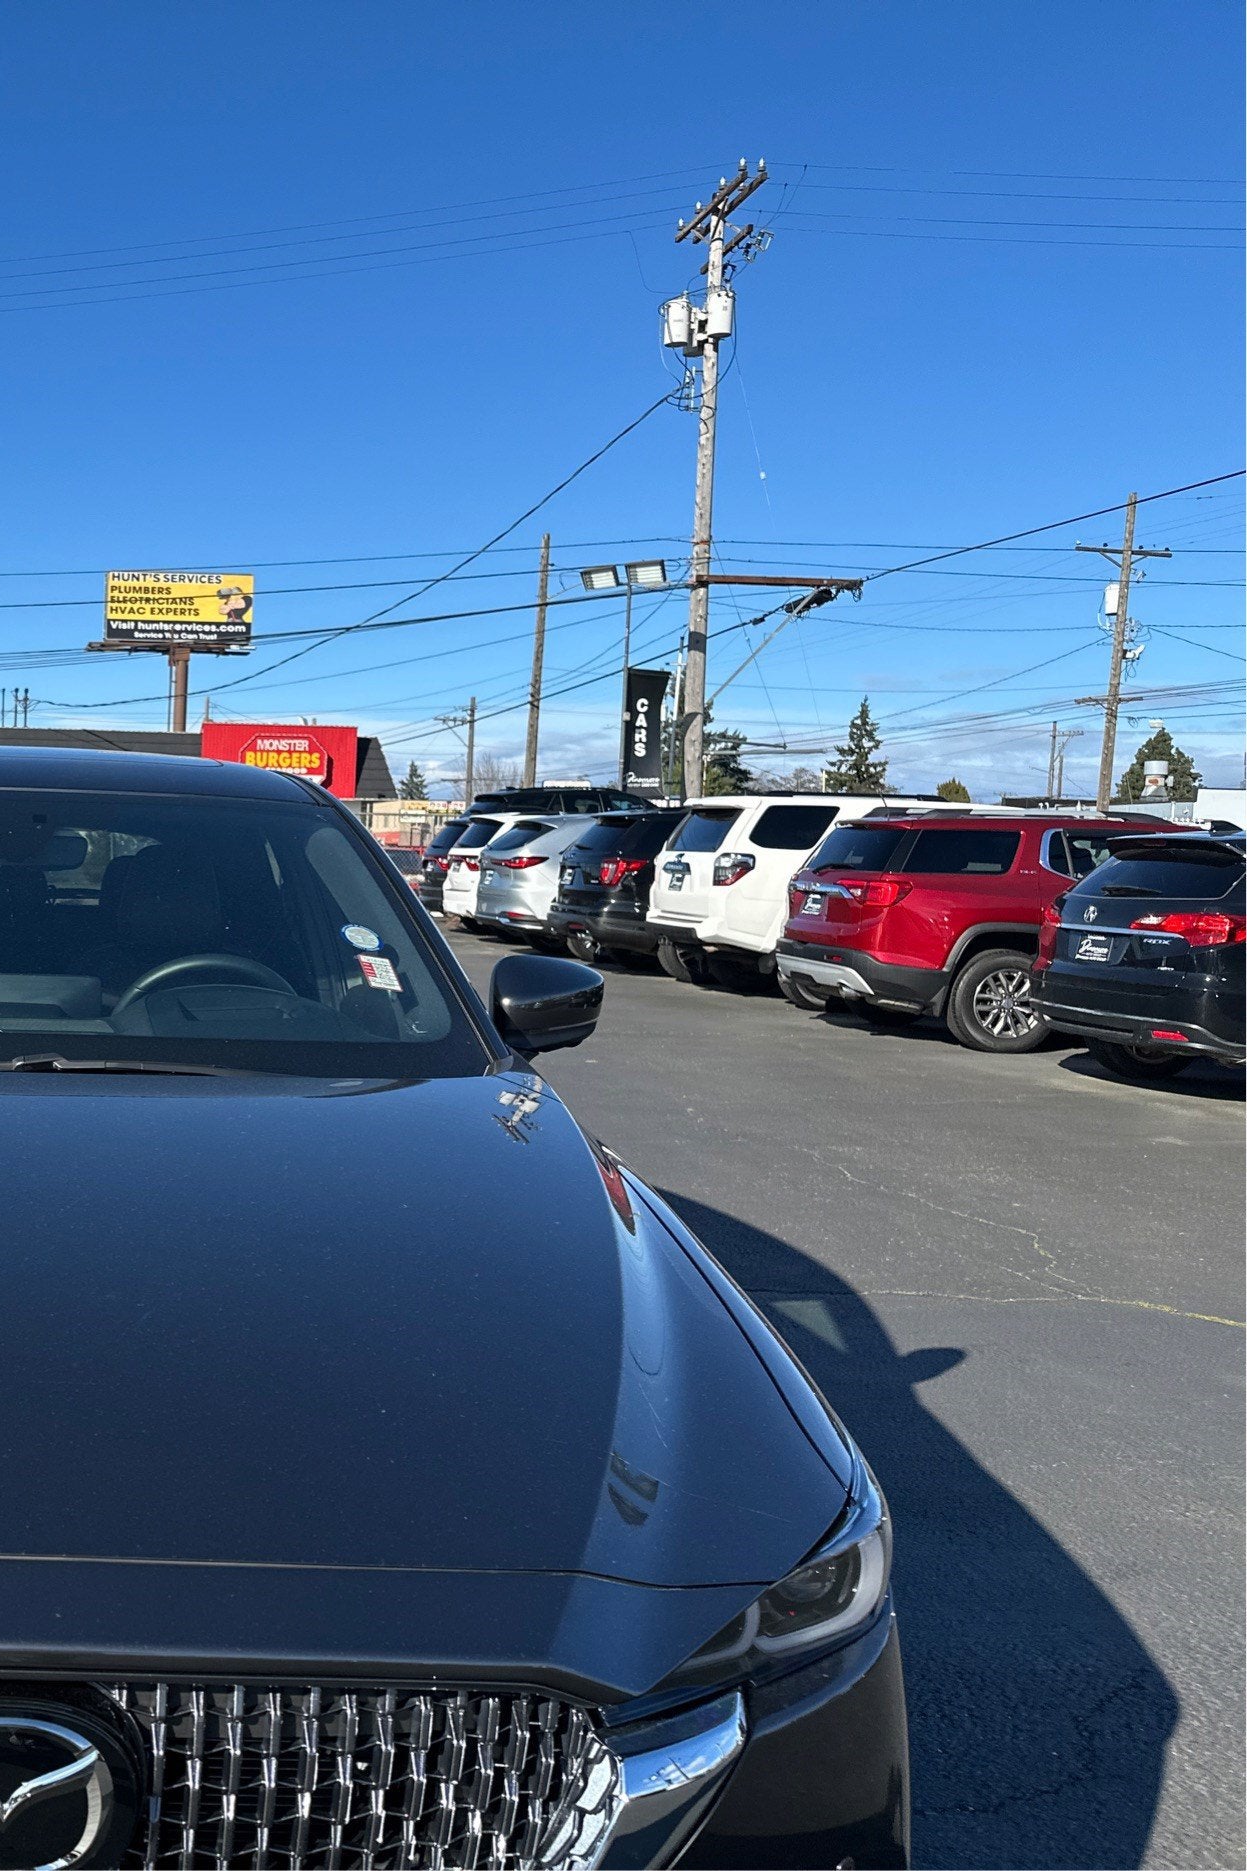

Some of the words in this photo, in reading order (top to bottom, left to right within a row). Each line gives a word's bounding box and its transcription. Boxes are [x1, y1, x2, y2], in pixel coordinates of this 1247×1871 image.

[112, 573, 160, 583] HUNT'S
[163, 574, 222, 584] SERVICES
[110, 585, 172, 595] PLUMBERS
[110, 596, 195, 606] ELECTRICIANS
[110, 606, 146, 615] HVAC
[150, 607, 200, 616] EXPERTS
[110, 621, 135, 630] Visit
[180, 632, 198, 640] Can
[634, 698, 649, 757] CARS
[256, 739, 309, 751] MONSTER
[245, 751, 321, 769] BURGERS
